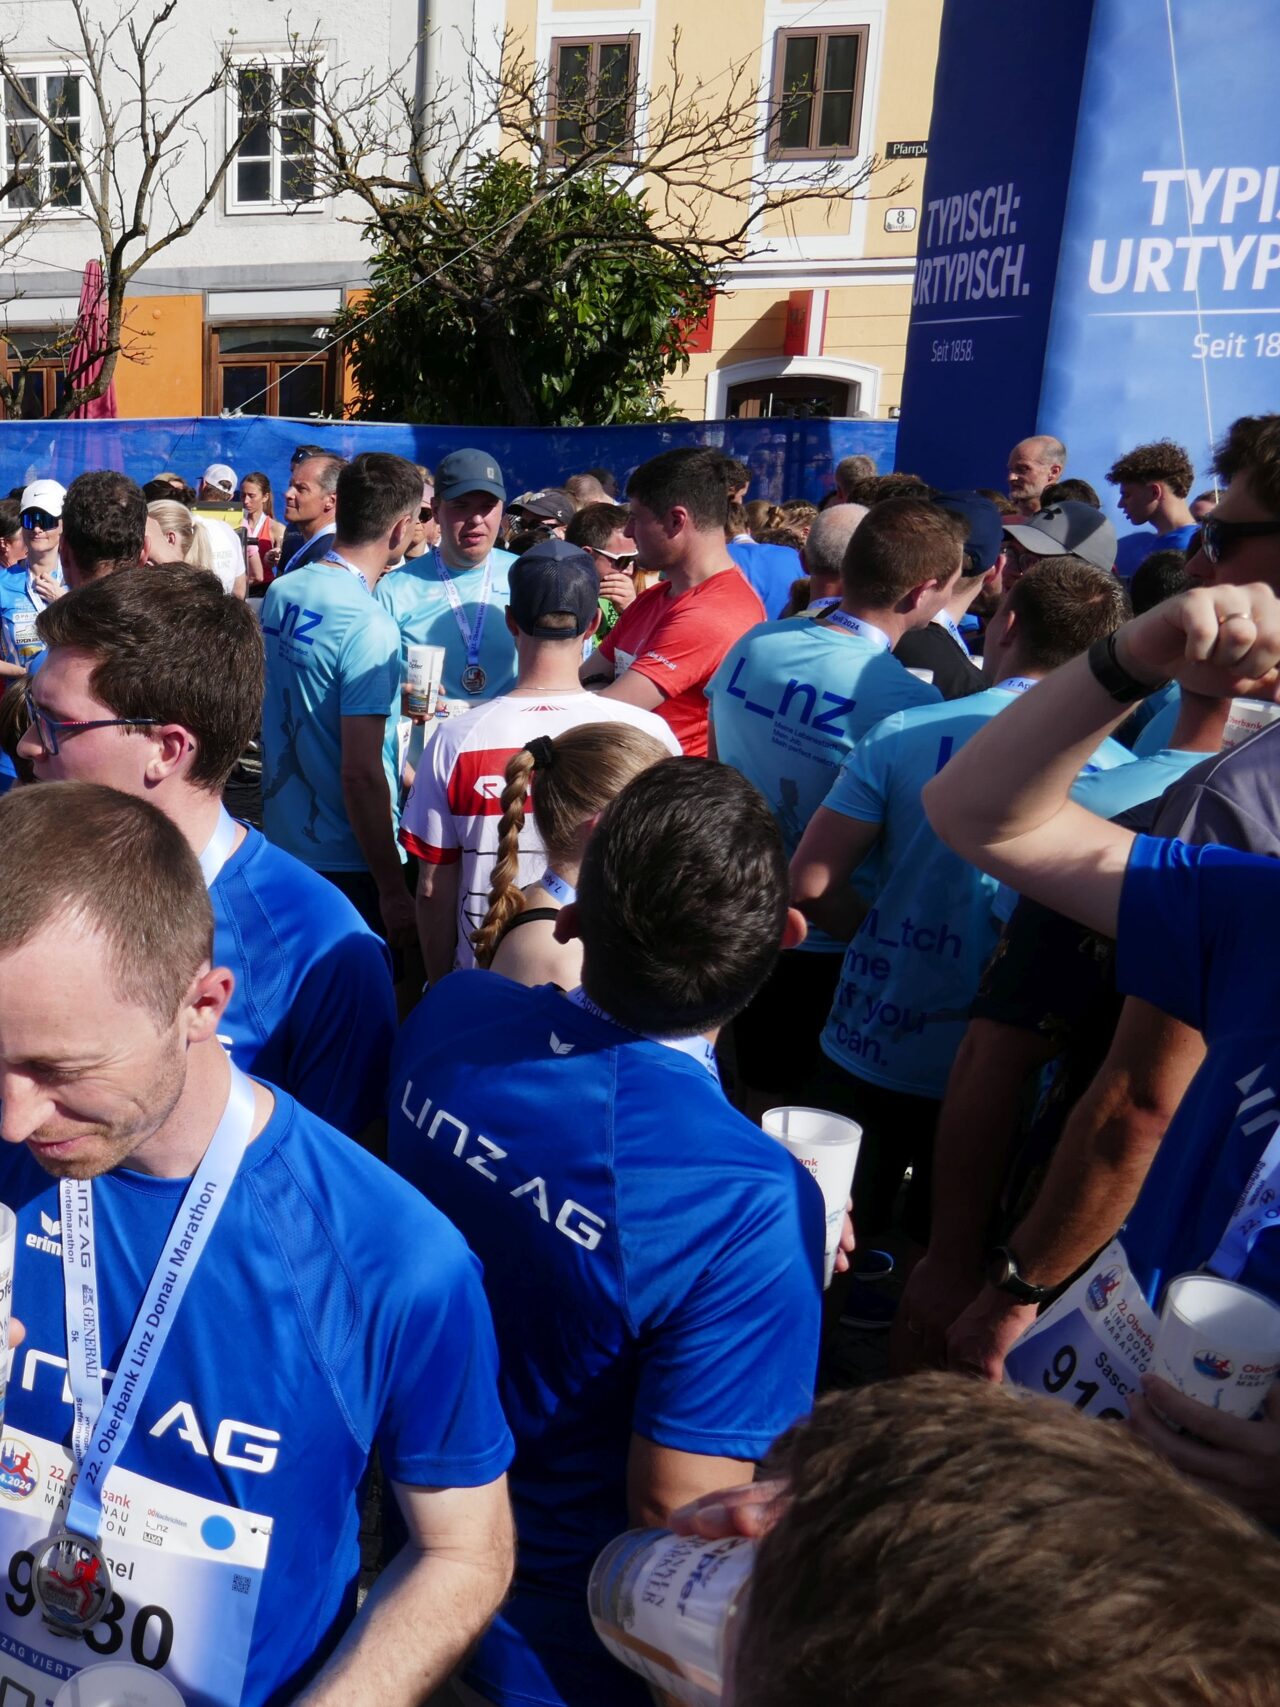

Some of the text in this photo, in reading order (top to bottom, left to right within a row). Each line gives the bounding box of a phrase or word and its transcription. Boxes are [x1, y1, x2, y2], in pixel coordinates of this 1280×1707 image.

[896, 210, 905, 225] 8
[926, 183, 1021, 248] TYPISCH:
[1142, 165, 1280, 226] TYPI
[930, 339, 975, 362] Seit 1858.
[1191, 332, 1247, 359] Seit
[260, 602, 324, 646] _nz
[844, 617, 861, 631] 2024
[726, 656, 857, 738] L_nz
[836, 1022, 889, 1067] can.
[400, 1079, 607, 1251] LINZ AG
[65, 1178, 75, 1264] Viertelmarathon
[25, 1232, 63, 1257] erim
[79, 1234, 92, 1268] AG
[70, 1329, 80, 1345] 5k
[83, 1307, 99, 1380] GENERALI
[84, 1180, 218, 1487] 22. Oberbank Linz Donau Marathon
[1102, 1316, 1147, 1374] MARATHO
[1108, 1307, 1153, 1363] LINZ DONA
[1125, 1313, 1155, 1353] Oberba
[1094, 1351, 1136, 1397] Sasc
[149, 1400, 282, 1475] AG
[48, 1464, 68, 1485] 22.
[145, 1520, 170, 1534] L_nz
[4, 1550, 174, 1671] 930
